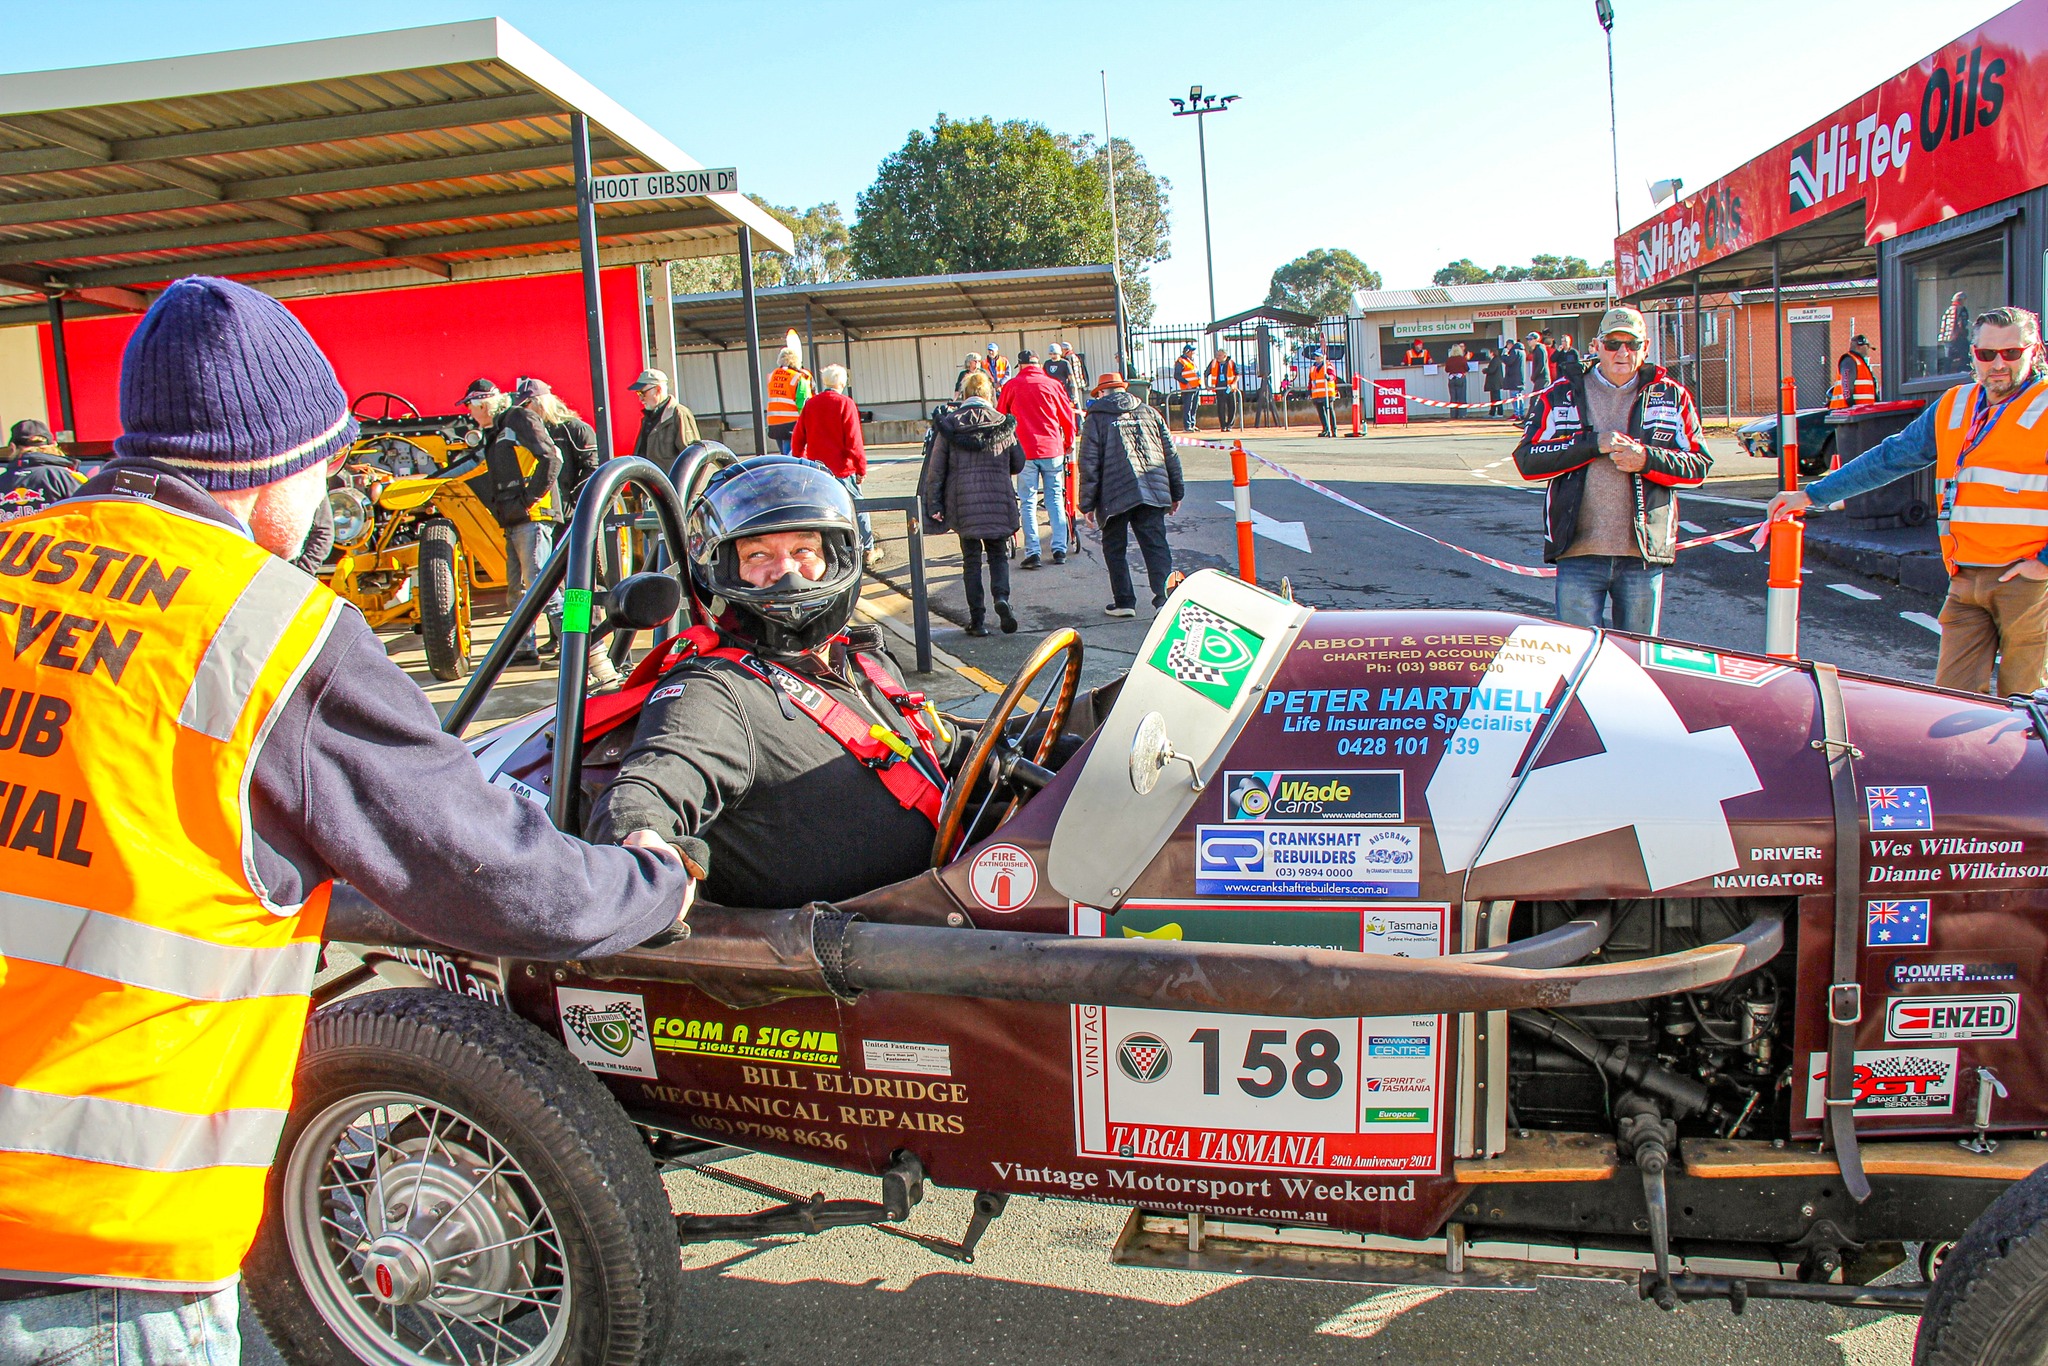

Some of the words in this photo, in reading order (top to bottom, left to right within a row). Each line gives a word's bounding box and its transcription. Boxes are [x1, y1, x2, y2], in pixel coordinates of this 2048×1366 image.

[1813, 112, 1913, 202] Hi-Tec
[1919, 45, 2006, 153] Oils
[594, 178, 639, 199] HOOT
[647, 172, 710, 196] GIBSON
[1651, 218, 1701, 276] Hi-Tec
[1704, 187, 1742, 251] Oils
[1478, 308, 1518, 318] PASSENGERS
[1519, 308, 1536, 316] SIGN
[1537, 307, 1548, 315] ON
[1560, 302, 1591, 310] EVENT
[1593, 299, 1626, 308] OFICE
[1396, 324, 1434, 334] DRIVERS
[1435, 323, 1457, 332] SIGN
[1458, 322, 1471, 330] ON
[1378, 388, 1402, 396] SIGN
[1383, 397, 1398, 405] ON
[1377, 407, 1405, 415] HERE
[1530, 438, 1576, 455] HOLDEN
[0, 509, 24, 522] Red
[0, 530, 191, 613] USTIN
[1296, 637, 1393, 650] ABBOTT
[1401, 636, 1418, 646] &
[1424, 634, 1572, 655] CHEESEMAN
[1323, 650, 1422, 663] CHARTERED
[1425, 649, 1546, 665] ACCOUNTANTS
[1366, 663, 1392, 674] Ph:
[1396, 662, 1425, 674] (03)
[1429, 661, 1465, 672] 9867
[1469, 661, 1504, 674] 6400
[1263, 688, 1370, 714] PETER
[1379, 686, 1551, 715] HARTNELL
[1283, 715, 1321, 732] Life
[1326, 714, 1426, 731] Insurance
[1432, 713, 1533, 734] Specialist
[1337, 737, 1386, 755] 0428
[1394, 737, 1428, 754] 101
[1444, 737, 1480, 754] 139
[1281, 779, 1351, 802] Wade
[1274, 797, 1323, 813] Cams
[1322, 811, 1400, 819] www.wadecams.com
[1268, 832, 1361, 847] CRANKSHAFT
[1369, 831, 1412, 846] AUSCRANK
[1751, 847, 1822, 861] DRIVER:
[1869, 840, 1912, 857] Wes
[1919, 837, 2024, 856] Wilkinson
[991, 852, 1016, 861] FIRE
[1273, 849, 1356, 865] REBUILDERS
[1275, 868, 1296, 878] (03)
[1298, 868, 1324, 878] 9894
[1326, 868, 1353, 878] 0000
[1868, 865, 1942, 883] Dianne
[1948, 862, 2048, 880] Wilkinson
[1224, 882, 1389, 894] www.crankshaftrebuilders.com.au
[1713, 873, 1823, 889] NAVIGATOR:
[1388, 920, 1438, 930] Tasmania
[1957, 974, 2014, 982] Balancers
[587, 1013, 623, 1022] SHANNONS
[1931, 1006, 2006, 1029] ENZED
[653, 1017, 724, 1041] FORM
[732, 1025, 748, 1043] A
[756, 1027, 821, 1051] SIGN
[1084, 1005, 1099, 1078] VINTAG
[699, 1041, 735, 1053] SIGNS
[737, 1044, 791, 1060] STICKERS
[792, 1050, 839, 1063] DESIGN
[865, 1041, 889, 1049] United
[891, 1043, 926, 1051] Fasteners
[1374, 1046, 1426, 1055] CENTRE
[586, 1060, 605, 1068] SHARE
[605, 1061, 618, 1070] THE
[618, 1063, 643, 1072] PASSION
[1188, 1028, 1344, 1100] 158
[741, 1065, 807, 1090] BILL
[815, 1072, 968, 1104] ELDRIDGE
[1867, 1095, 1899, 1103] BRAKE
[1909, 1094, 1947, 1102] CLUTCH
[641, 1083, 829, 1122] MECHANICAL
[838, 1106, 965, 1135] REPAIRS
[1378, 1110, 1416, 1118] Europcar
[690, 1114, 734, 1135] (03)
[736, 1121, 788, 1143] 9798
[794, 1128, 848, 1151] 8636
[1110, 1126, 1190, 1158] TARGA
[1197, 1131, 1326, 1166] TASMANIA
[1329, 1154, 1351, 1167] 20th
[1352, 1155, 1408, 1170] Anniversary
[1409, 1155, 1432, 1167] 2011
[991, 1160, 1099, 1188] Vintage
[1107, 1168, 1272, 1200] Motorsport
[1279, 1178, 1417, 1202] Weekend
